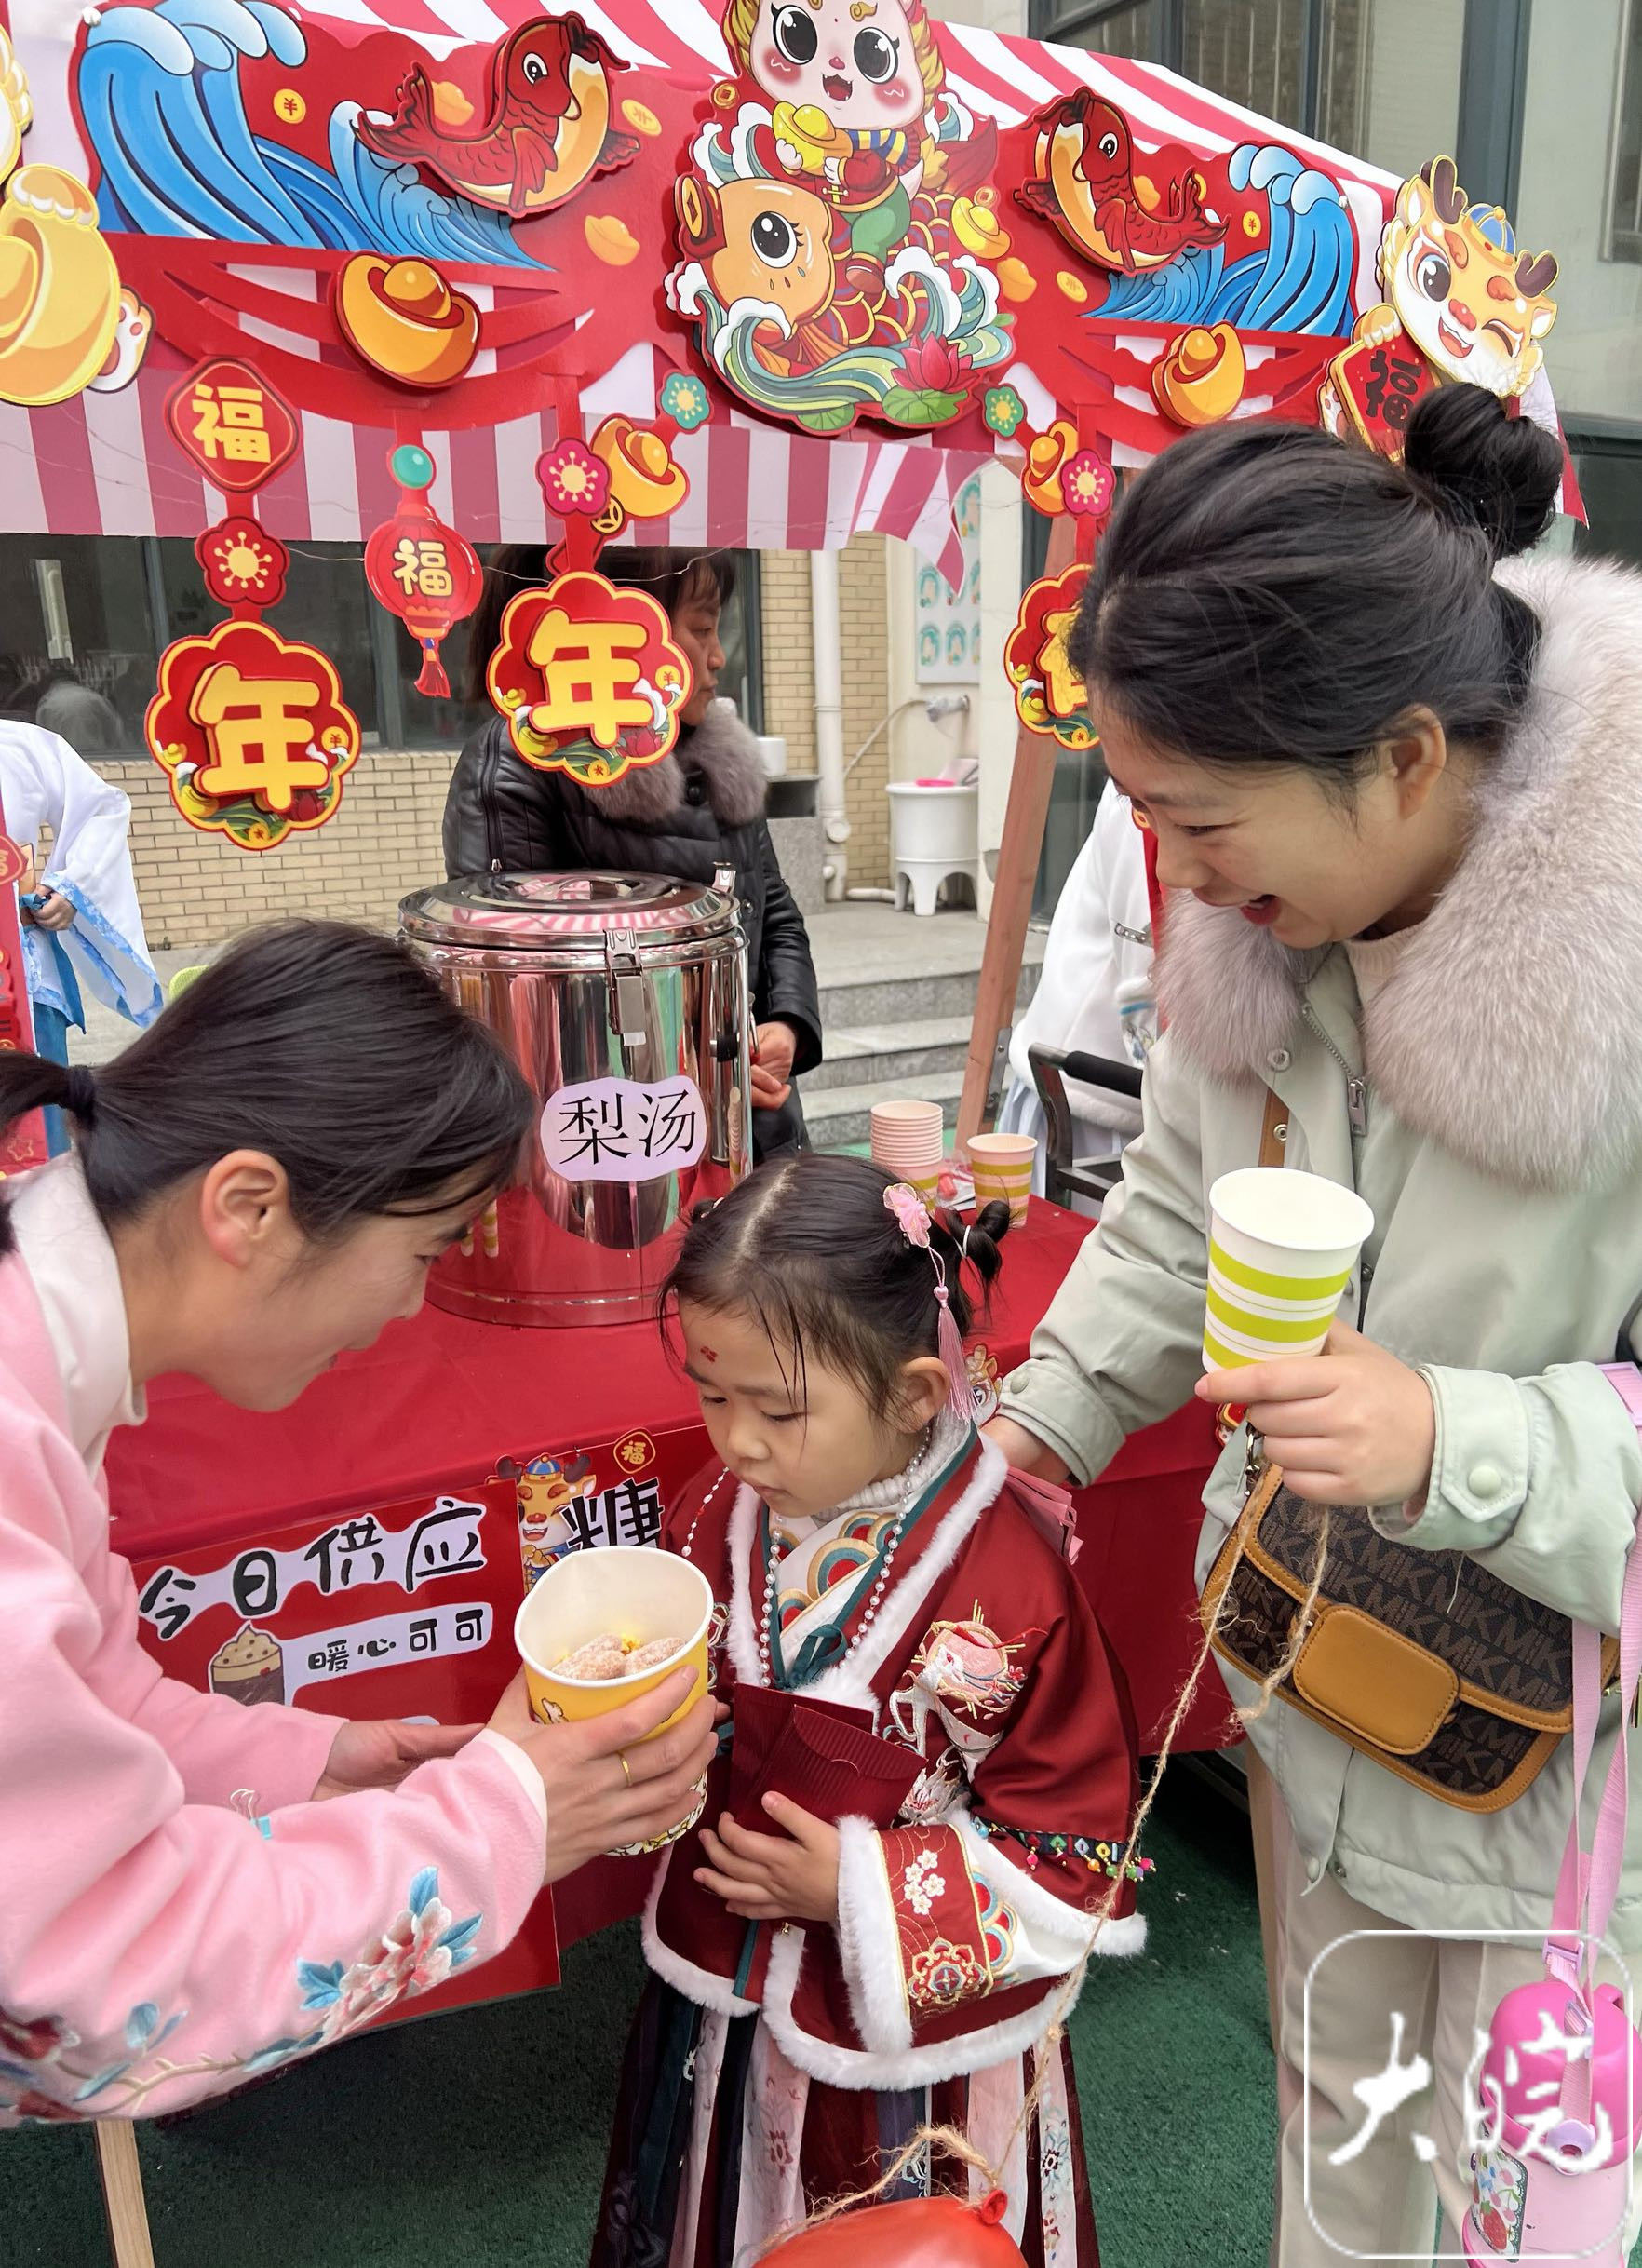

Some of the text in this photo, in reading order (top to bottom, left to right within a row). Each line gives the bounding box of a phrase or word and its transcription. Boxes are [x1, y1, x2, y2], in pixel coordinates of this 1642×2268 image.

[192, 383, 272, 464] 福
[1365, 349, 1422, 431] 福
[392, 538, 453, 598] 福
[529, 608, 653, 747] 年
[193, 664, 330, 811] 年
[558, 1088, 696, 1165] 梨汤
[620, 1440, 647, 1465] 福
[139, 1499, 485, 1640] 今日供应
[307, 1608, 484, 1672] 暖心可可
